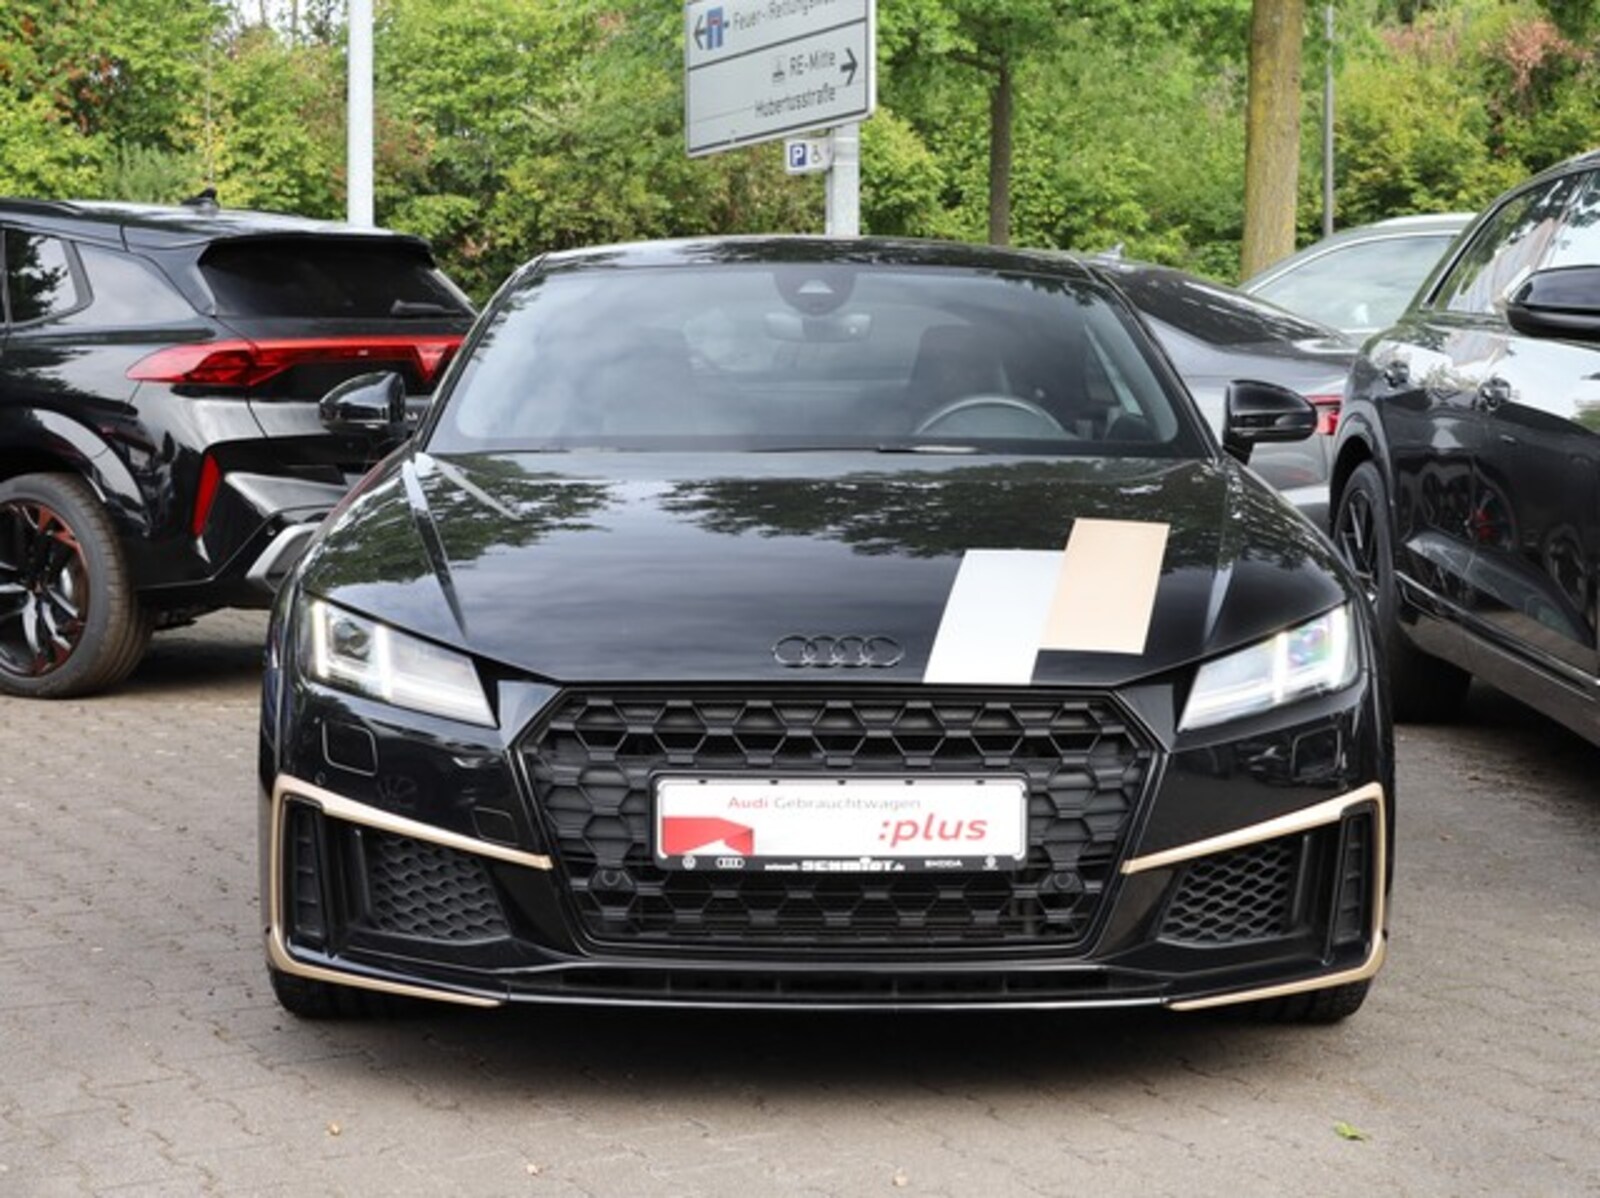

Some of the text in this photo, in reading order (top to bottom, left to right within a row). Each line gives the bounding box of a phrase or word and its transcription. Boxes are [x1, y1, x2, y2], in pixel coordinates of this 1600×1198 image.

[790, 51, 836, 77] RE-Mitte
[754, 82, 836, 118] Hubertusstraße
[792, 146, 804, 167] P
[728, 796, 921, 812] Audi Gebrauchtwagen
[879, 812, 988, 849] :plus
